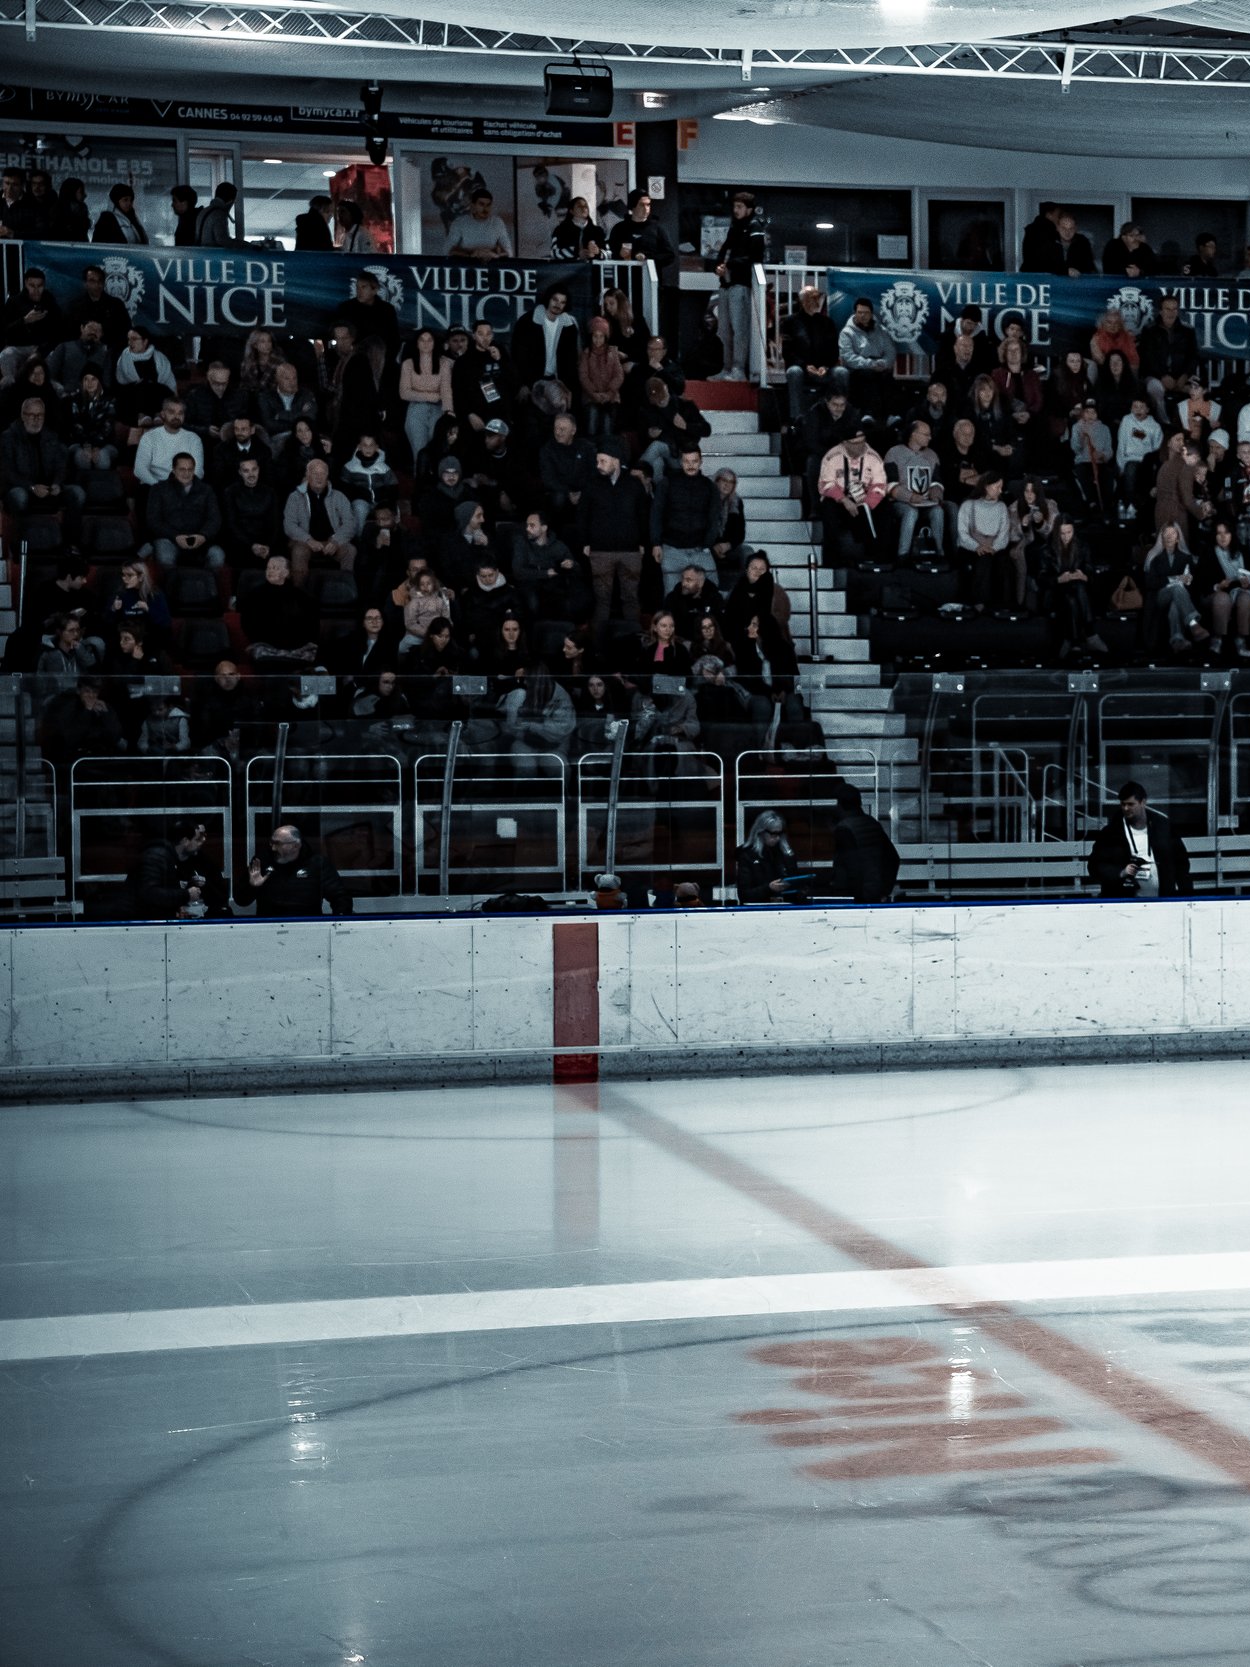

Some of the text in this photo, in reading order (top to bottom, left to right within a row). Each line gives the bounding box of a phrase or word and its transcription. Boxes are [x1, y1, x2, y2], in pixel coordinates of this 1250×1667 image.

[178, 106, 228, 119] CANNES
[617, 122, 633, 145] E
[681, 121, 698, 149] F
[152, 258, 287, 286] VILLE DE
[409, 265, 538, 293] VILLE DE
[155, 283, 287, 328] NICE
[935, 281, 1051, 306] VILLE DE
